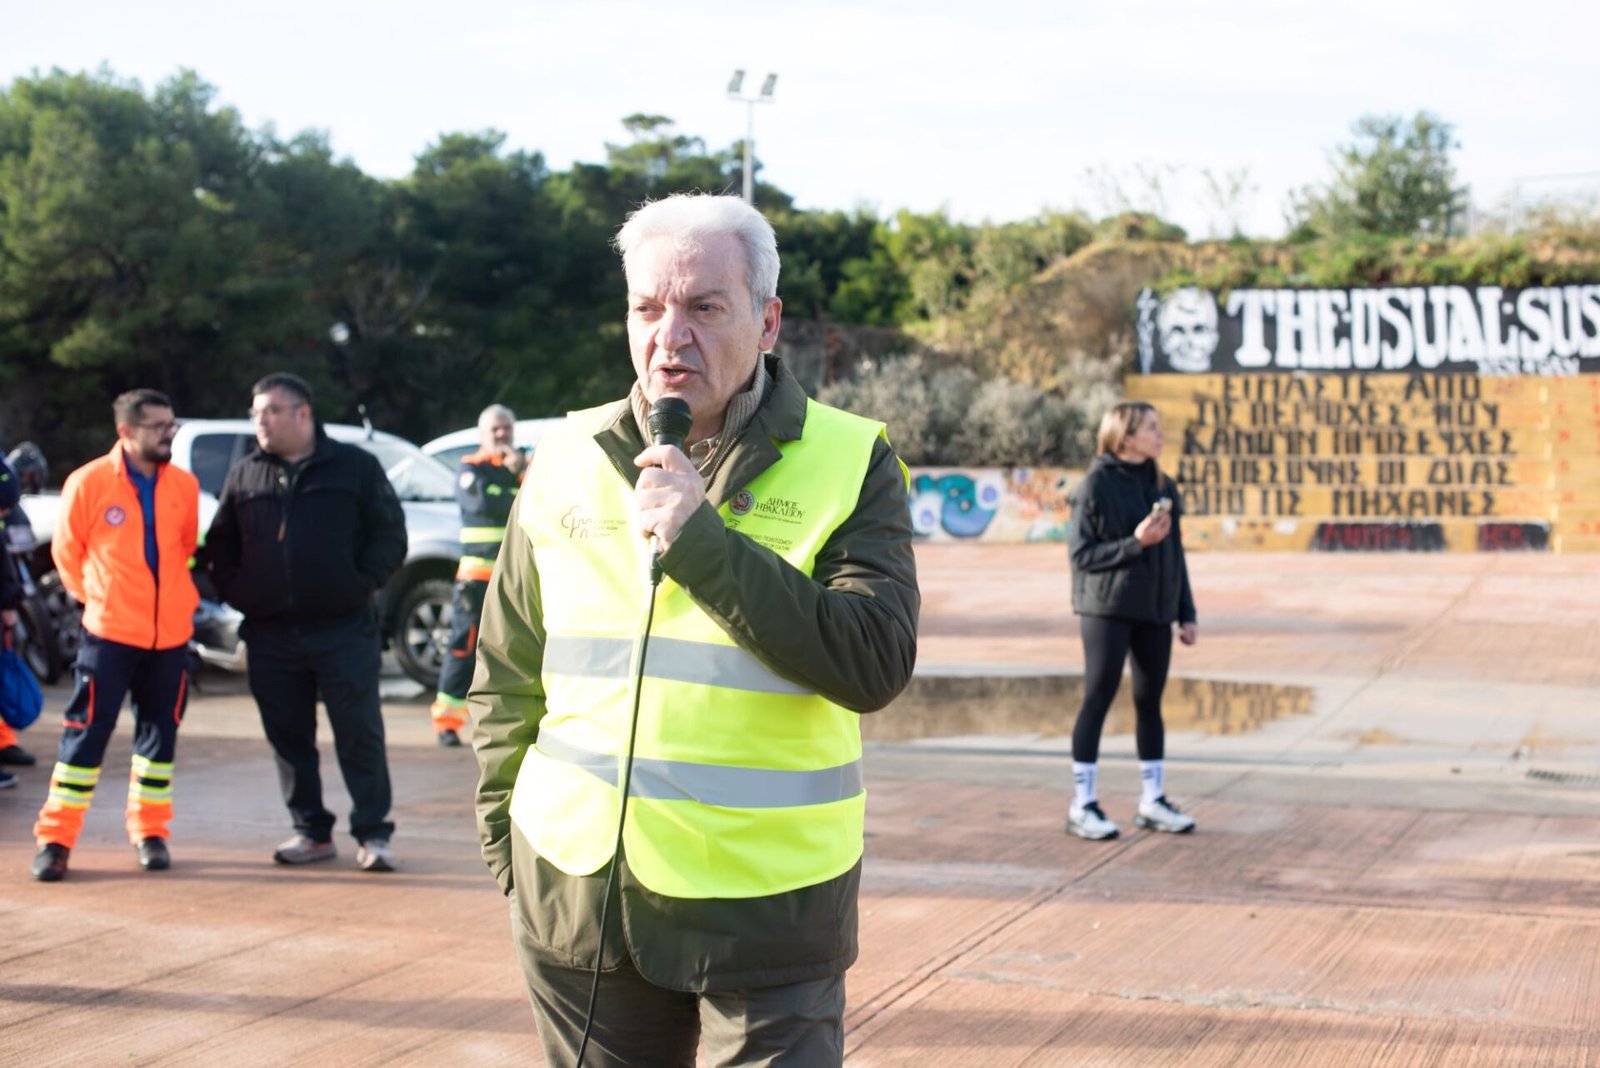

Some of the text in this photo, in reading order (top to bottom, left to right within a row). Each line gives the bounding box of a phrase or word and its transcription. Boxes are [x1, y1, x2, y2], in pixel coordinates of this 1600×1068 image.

[1227, 289, 1351, 367] THE
[1404, 374, 1481, 400] ΑΠΟ
[1427, 460, 1515, 485] ΔΙΑΣ
